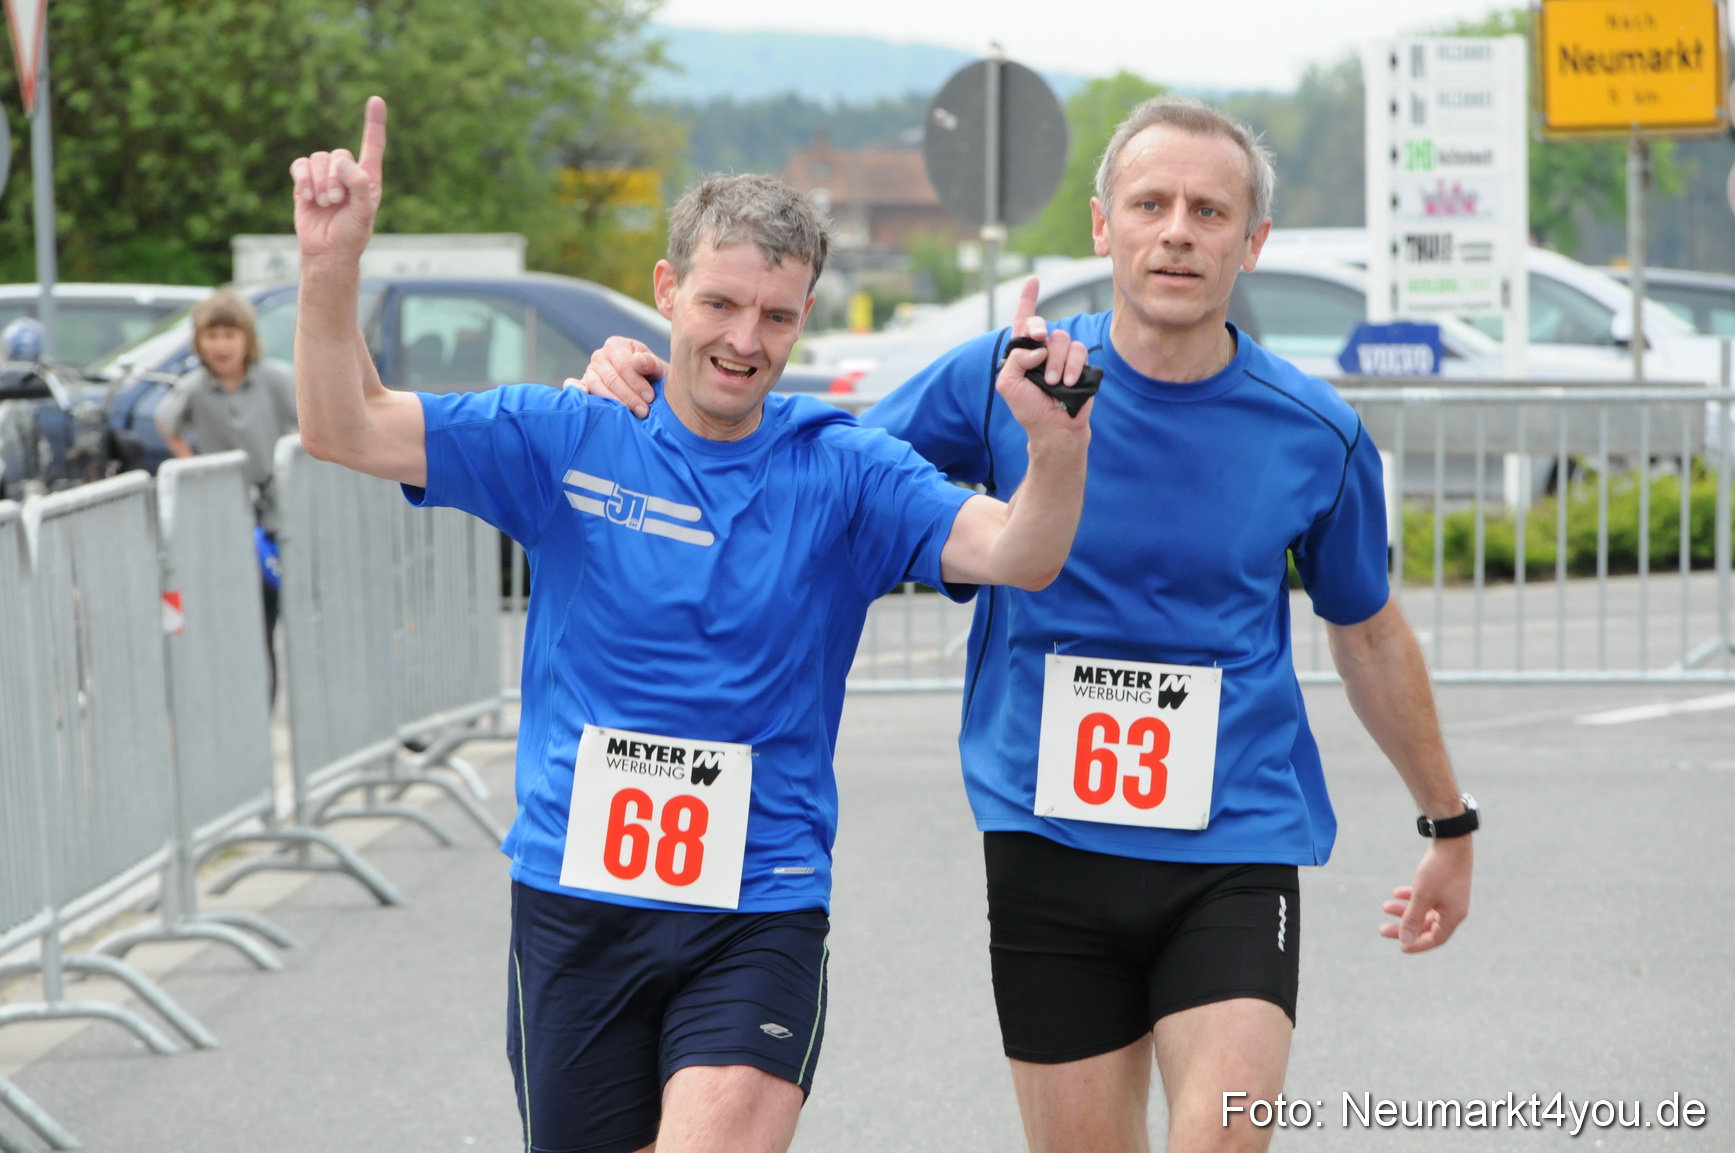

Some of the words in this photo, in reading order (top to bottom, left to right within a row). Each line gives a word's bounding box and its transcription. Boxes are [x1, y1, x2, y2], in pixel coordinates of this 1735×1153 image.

[1559, 38, 1704, 76] Neumarkt
[1356, 342, 1435, 375] VOLVO
[1073, 665, 1153, 690] MEYER
[1073, 684, 1152, 704] WERBUNG
[606, 737, 687, 765] MEYER
[1073, 712, 1171, 810] 63
[606, 756, 685, 780] WERBUNG
[603, 787, 709, 887] 68
